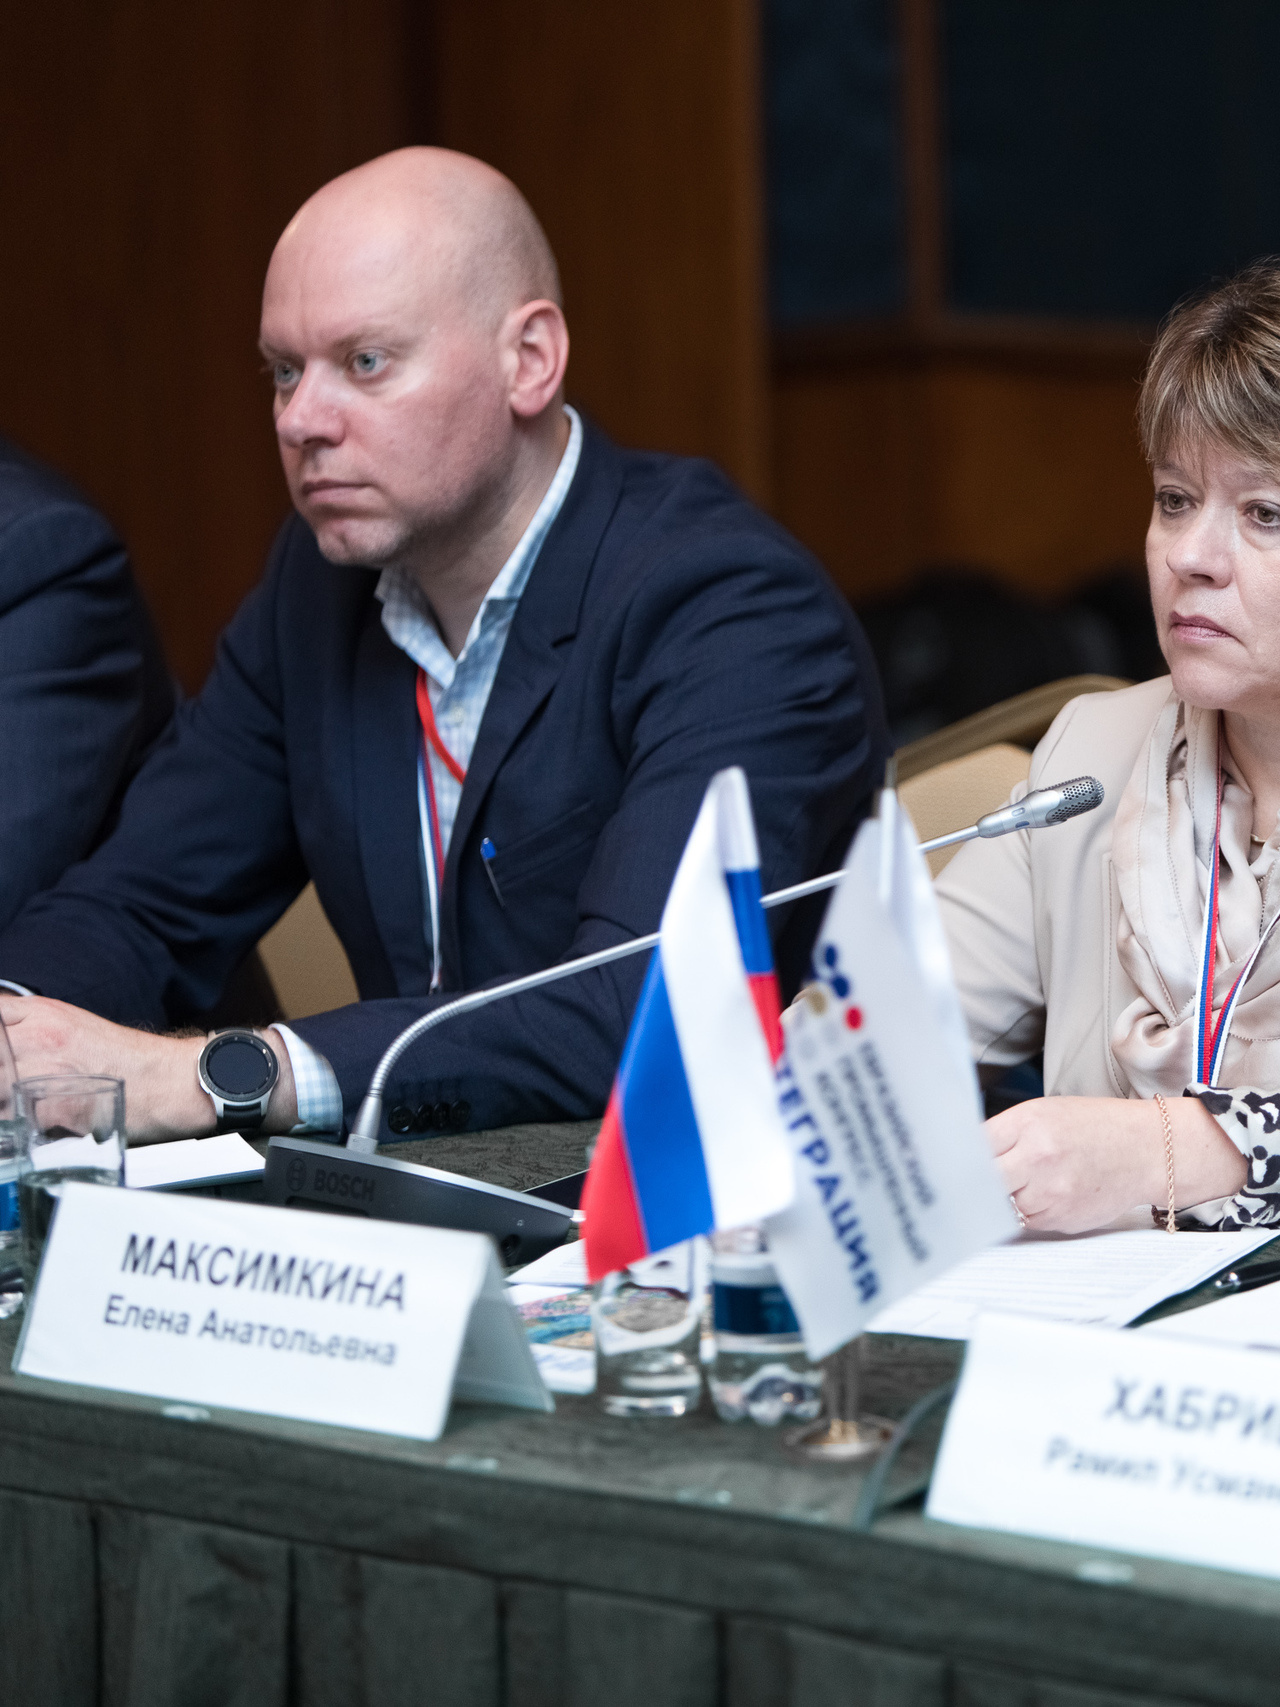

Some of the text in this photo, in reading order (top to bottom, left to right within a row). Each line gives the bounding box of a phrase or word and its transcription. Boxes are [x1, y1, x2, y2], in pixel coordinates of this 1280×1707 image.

[314, 1168, 376, 1201] BOSCH
[776, 1058, 881, 1302] ТЕГРАЦИЯ
[121, 1233, 405, 1310] МАКСИМКИНА
[104, 1295, 396, 1366] Елена Анатольевна
